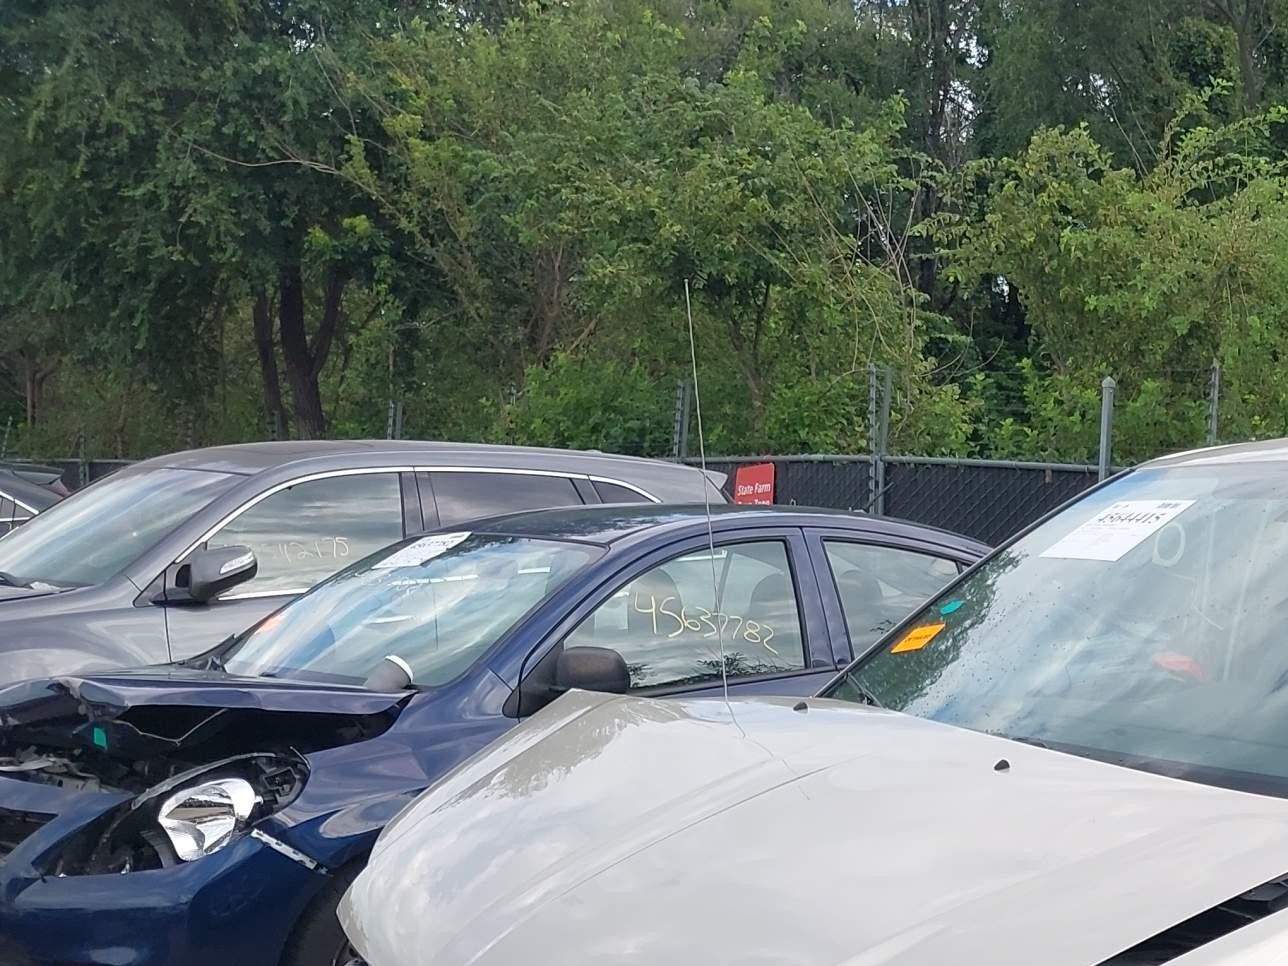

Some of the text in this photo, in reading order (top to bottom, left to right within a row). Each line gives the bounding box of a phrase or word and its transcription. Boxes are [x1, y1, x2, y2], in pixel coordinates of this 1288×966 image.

[737, 482, 771, 496] State Farm
[634, 591, 780, 656] 45637782
